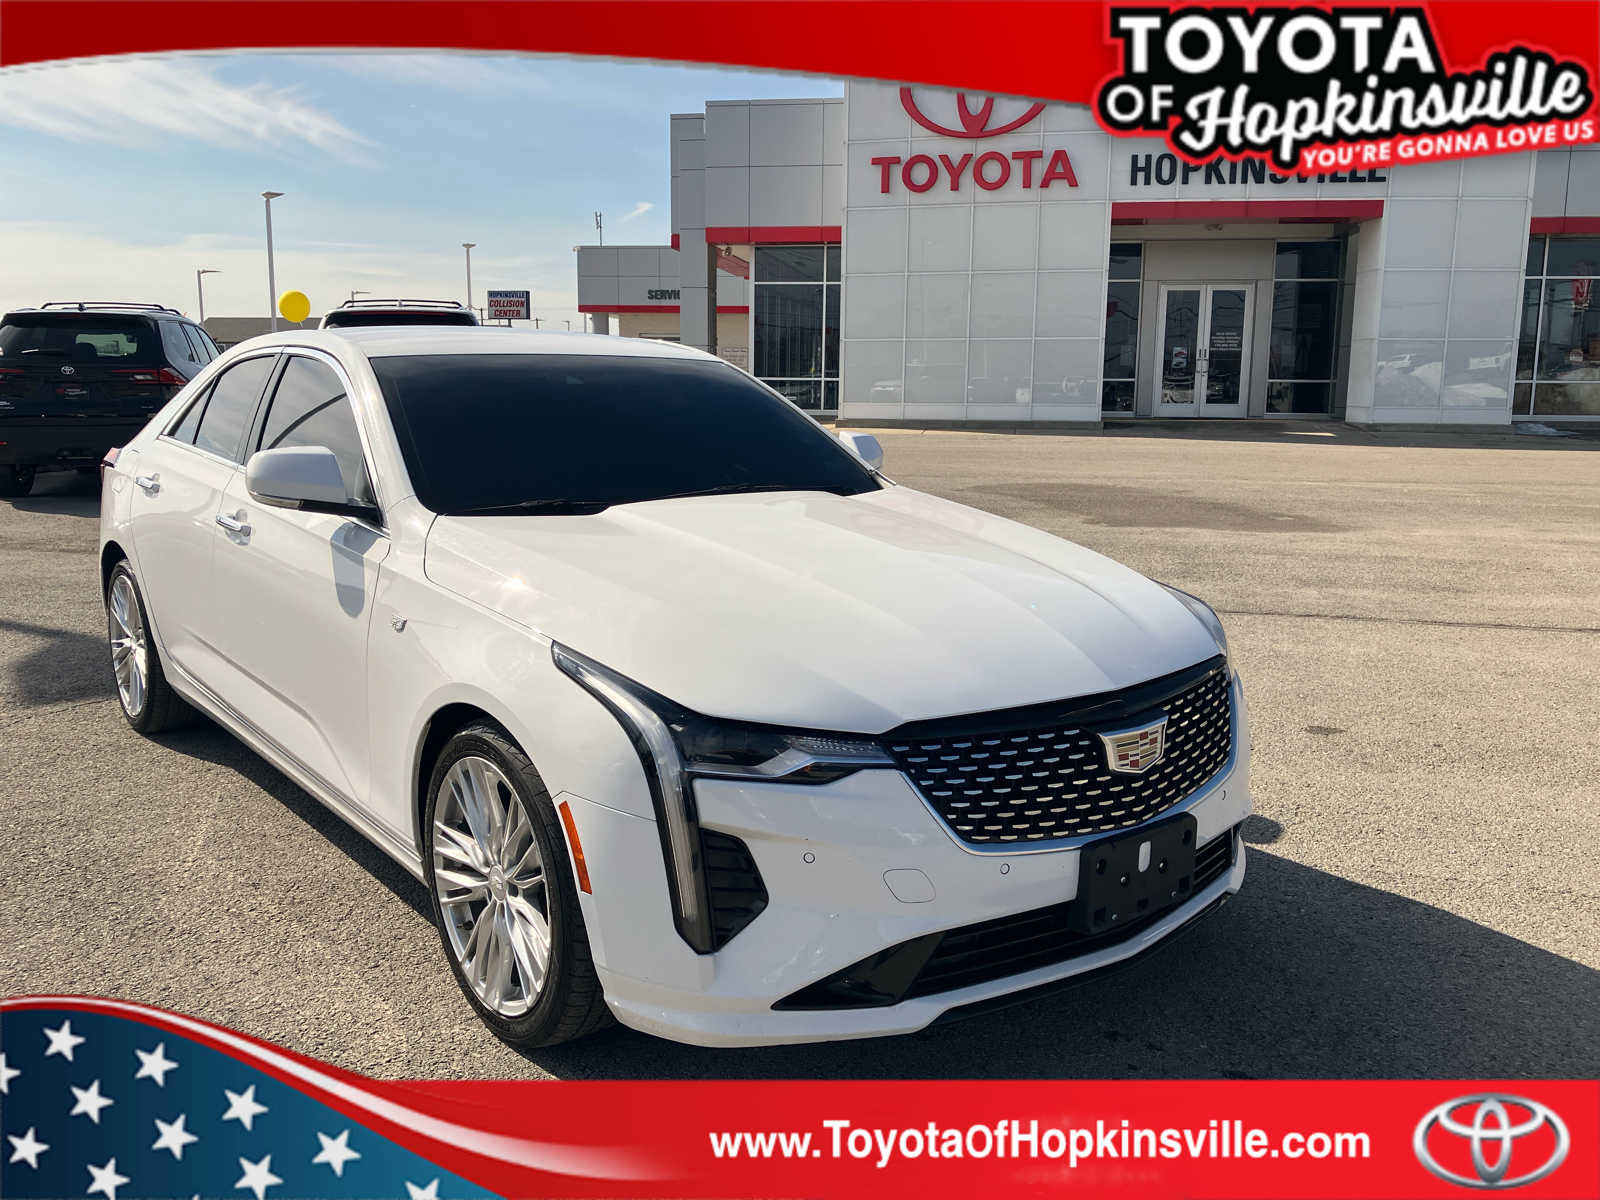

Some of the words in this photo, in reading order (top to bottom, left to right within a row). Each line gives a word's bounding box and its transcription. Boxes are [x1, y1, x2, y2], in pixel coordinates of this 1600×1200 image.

[871, 150, 1079, 194] TOYOTA
[1130, 153, 1387, 186] HOPKINLLE
[489, 299, 525, 308] COLLISION
[494, 309, 521, 318] CENTER
